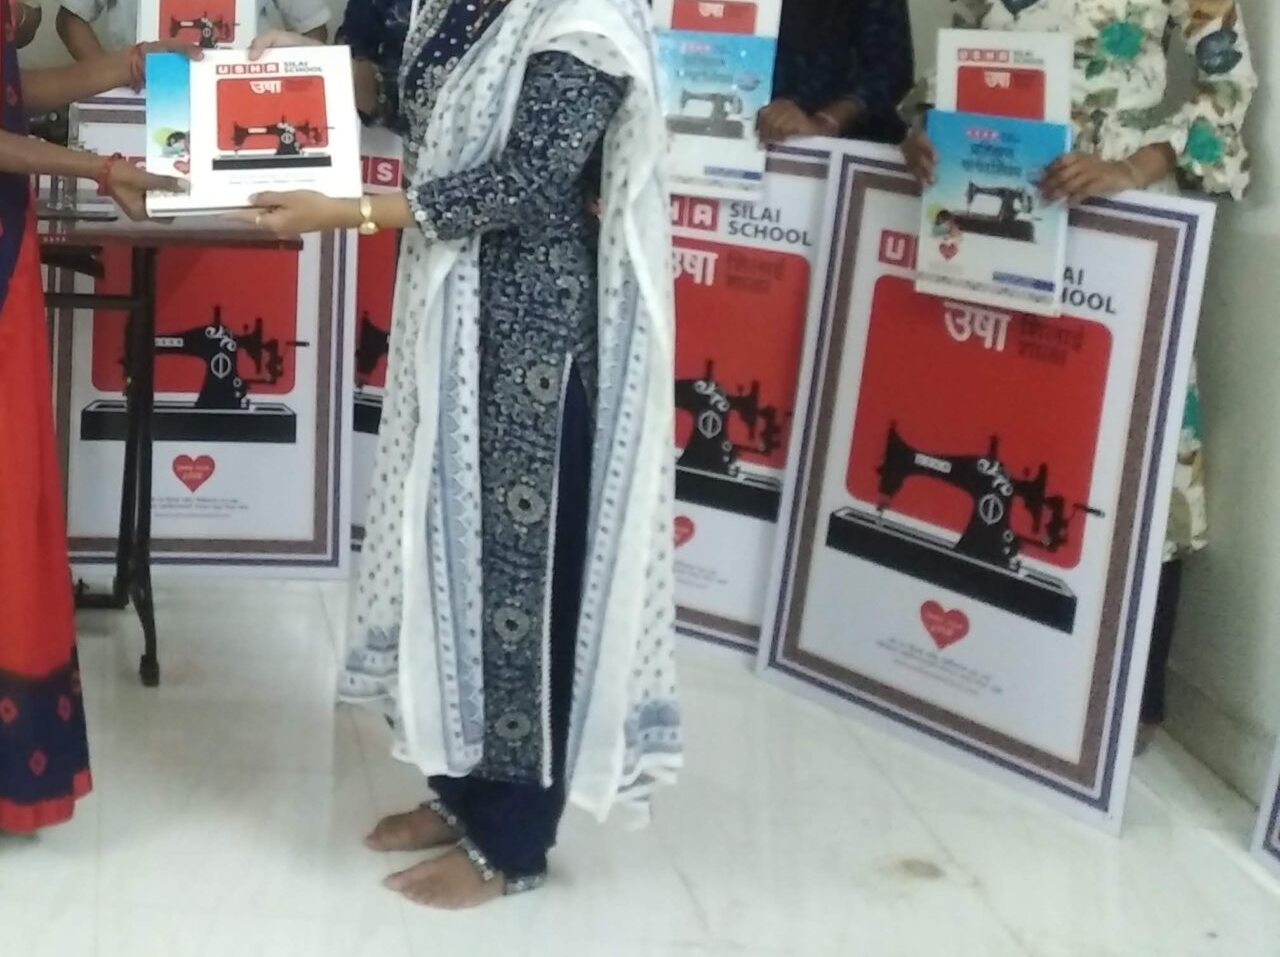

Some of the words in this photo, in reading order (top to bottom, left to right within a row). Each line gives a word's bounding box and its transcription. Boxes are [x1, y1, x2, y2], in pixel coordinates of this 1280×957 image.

[249, 79, 282, 94] उषा
[729, 202, 782, 223] SILAI
[728, 220, 813, 247] SCHOOL
[944, 301, 1012, 352] उषा
